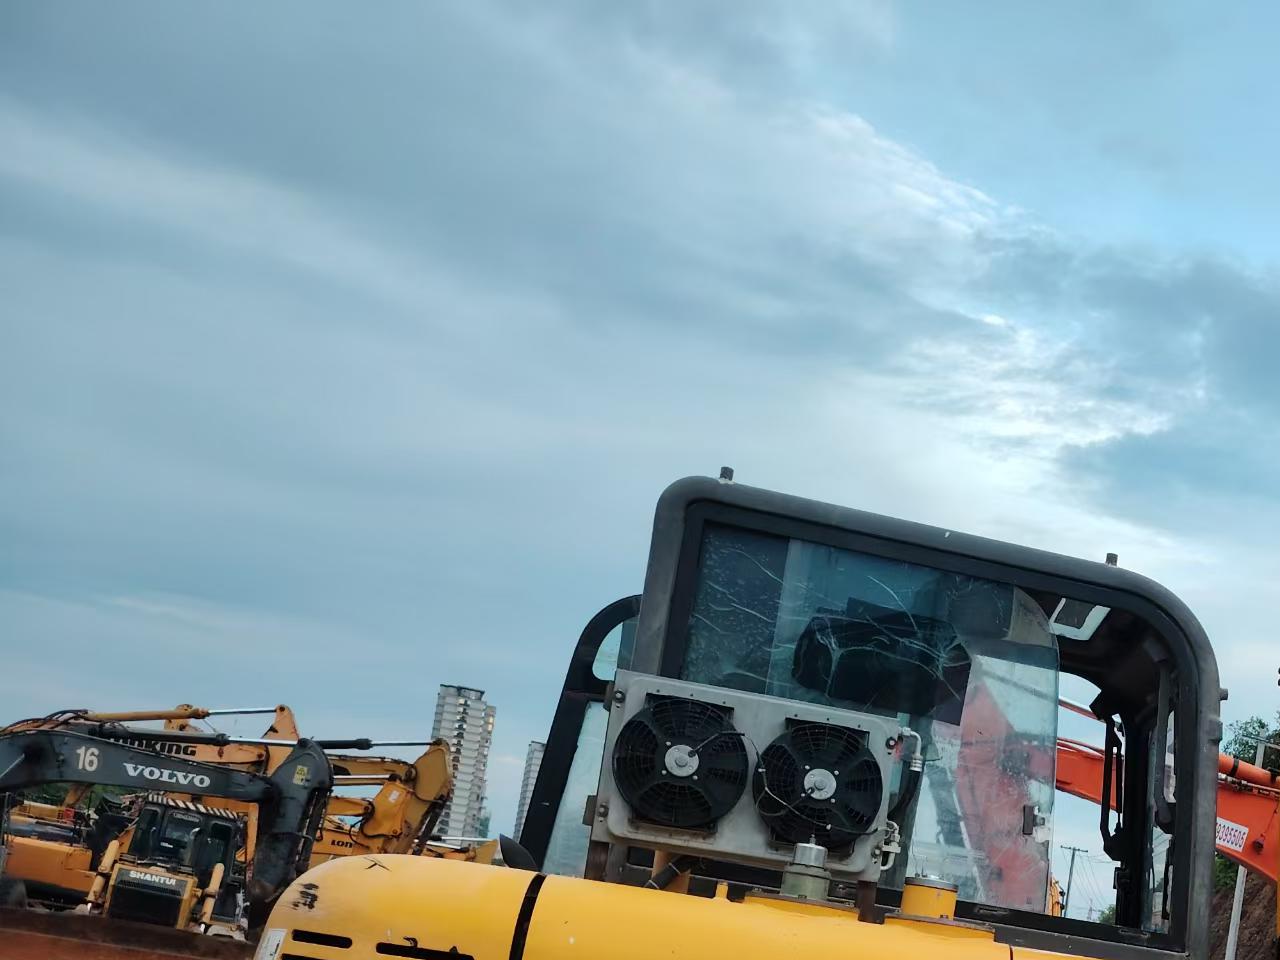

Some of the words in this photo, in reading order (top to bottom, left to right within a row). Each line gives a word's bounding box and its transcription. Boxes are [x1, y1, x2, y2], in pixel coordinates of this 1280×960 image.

[76, 746, 99, 772] 16
[123, 762, 211, 787] VOLVO
[1215, 823, 1246, 848] 9395505
[129, 870, 176, 886] SHANTUI
